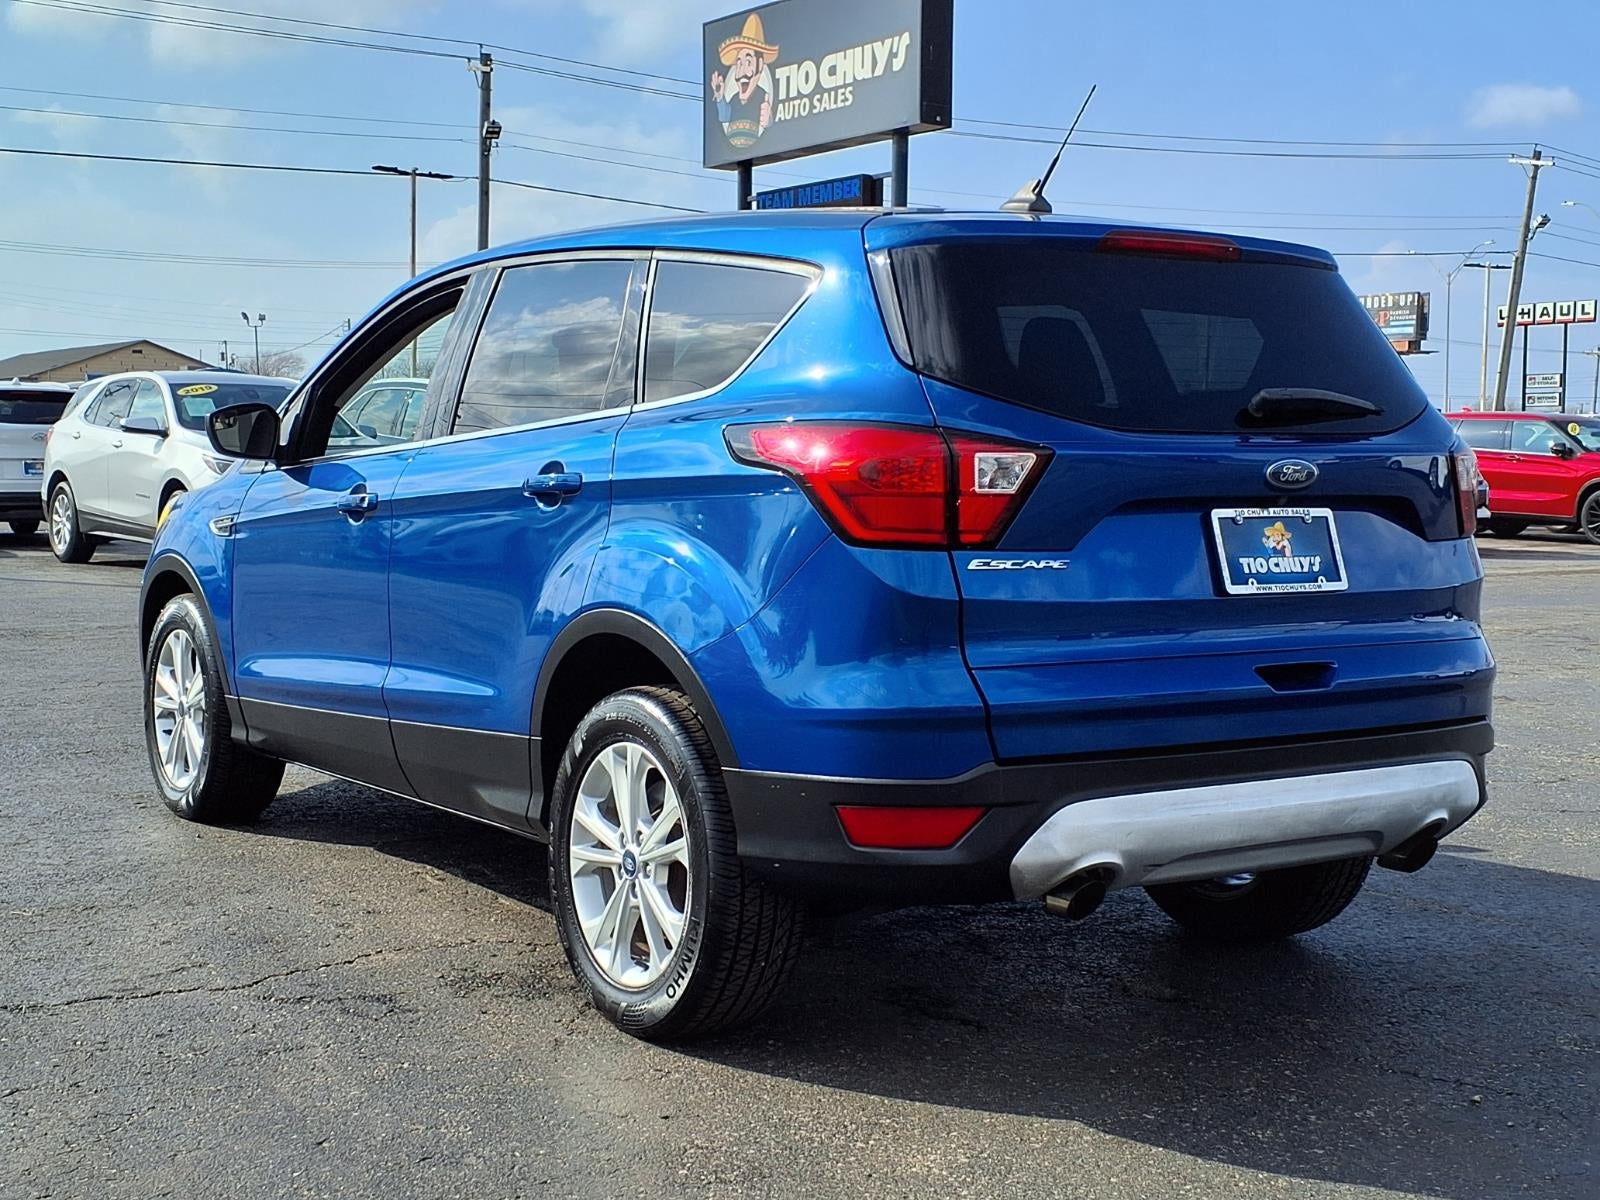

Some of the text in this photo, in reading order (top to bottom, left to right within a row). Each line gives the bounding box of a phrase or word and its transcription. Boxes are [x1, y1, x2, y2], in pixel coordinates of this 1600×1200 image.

[775, 32, 910, 100] TIO CHUY'S
[775, 87, 854, 122] AUTO SALES
[758, 178, 860, 208] TEAM MEMBER
[1280, 465, 1308, 481] Ford
[1239, 555, 1321, 574] TIO CHUY'S
[1255, 584, 1323, 592] WWW.TIOCHUYS.COM
[665, 915, 701, 999] KUMHO
